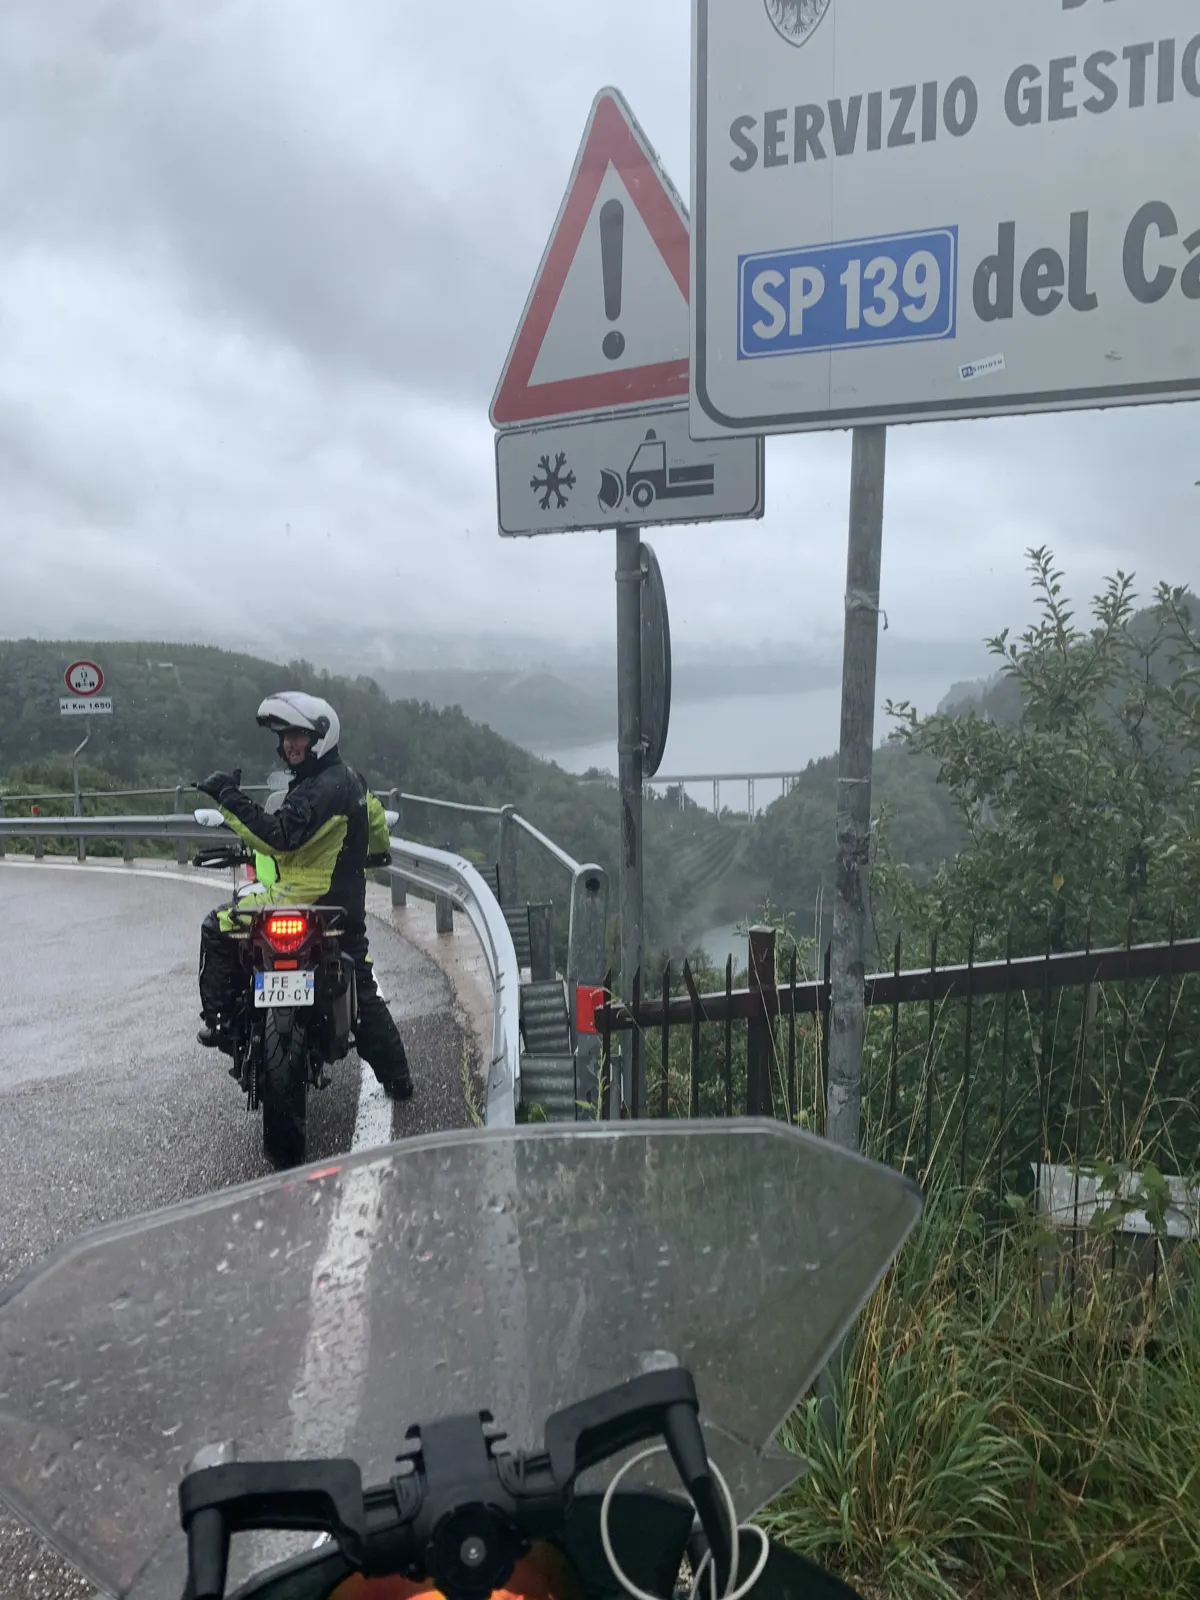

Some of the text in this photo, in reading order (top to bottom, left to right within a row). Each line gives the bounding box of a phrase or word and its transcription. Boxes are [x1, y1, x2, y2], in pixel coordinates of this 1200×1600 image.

[729, 75, 978, 172] SERVIZIO
[751, 266, 826, 340] SP
[840, 250, 941, 330] 139
[972, 210, 1099, 322] del
[258, 990, 285, 1002] 470
[271, 976, 289, 989] FE
